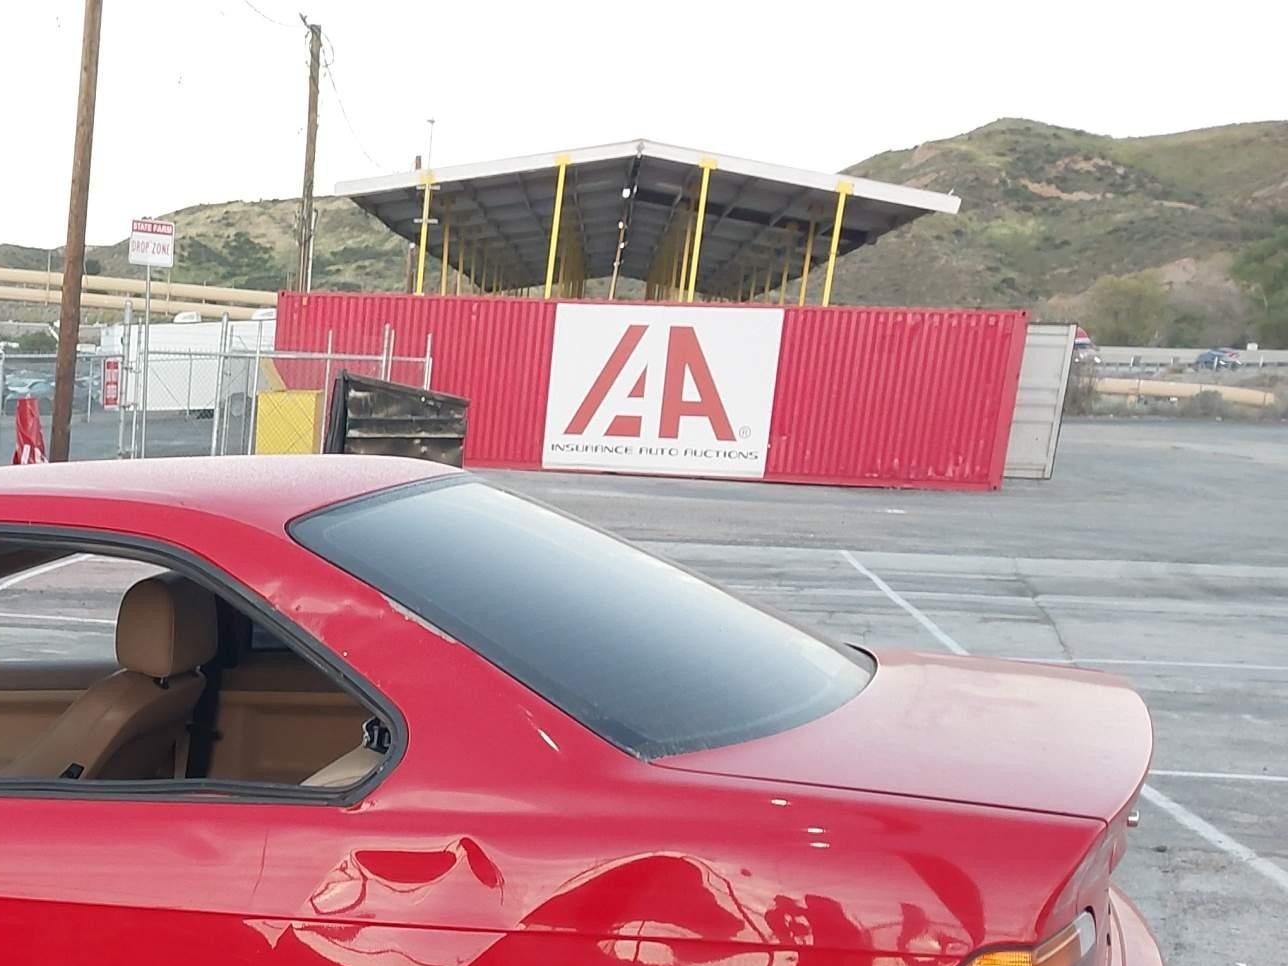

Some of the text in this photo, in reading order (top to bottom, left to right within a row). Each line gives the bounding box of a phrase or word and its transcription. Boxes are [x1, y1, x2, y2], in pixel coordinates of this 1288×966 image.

[551, 443, 759, 460] INSURANCE AUTO AUCTIONS
